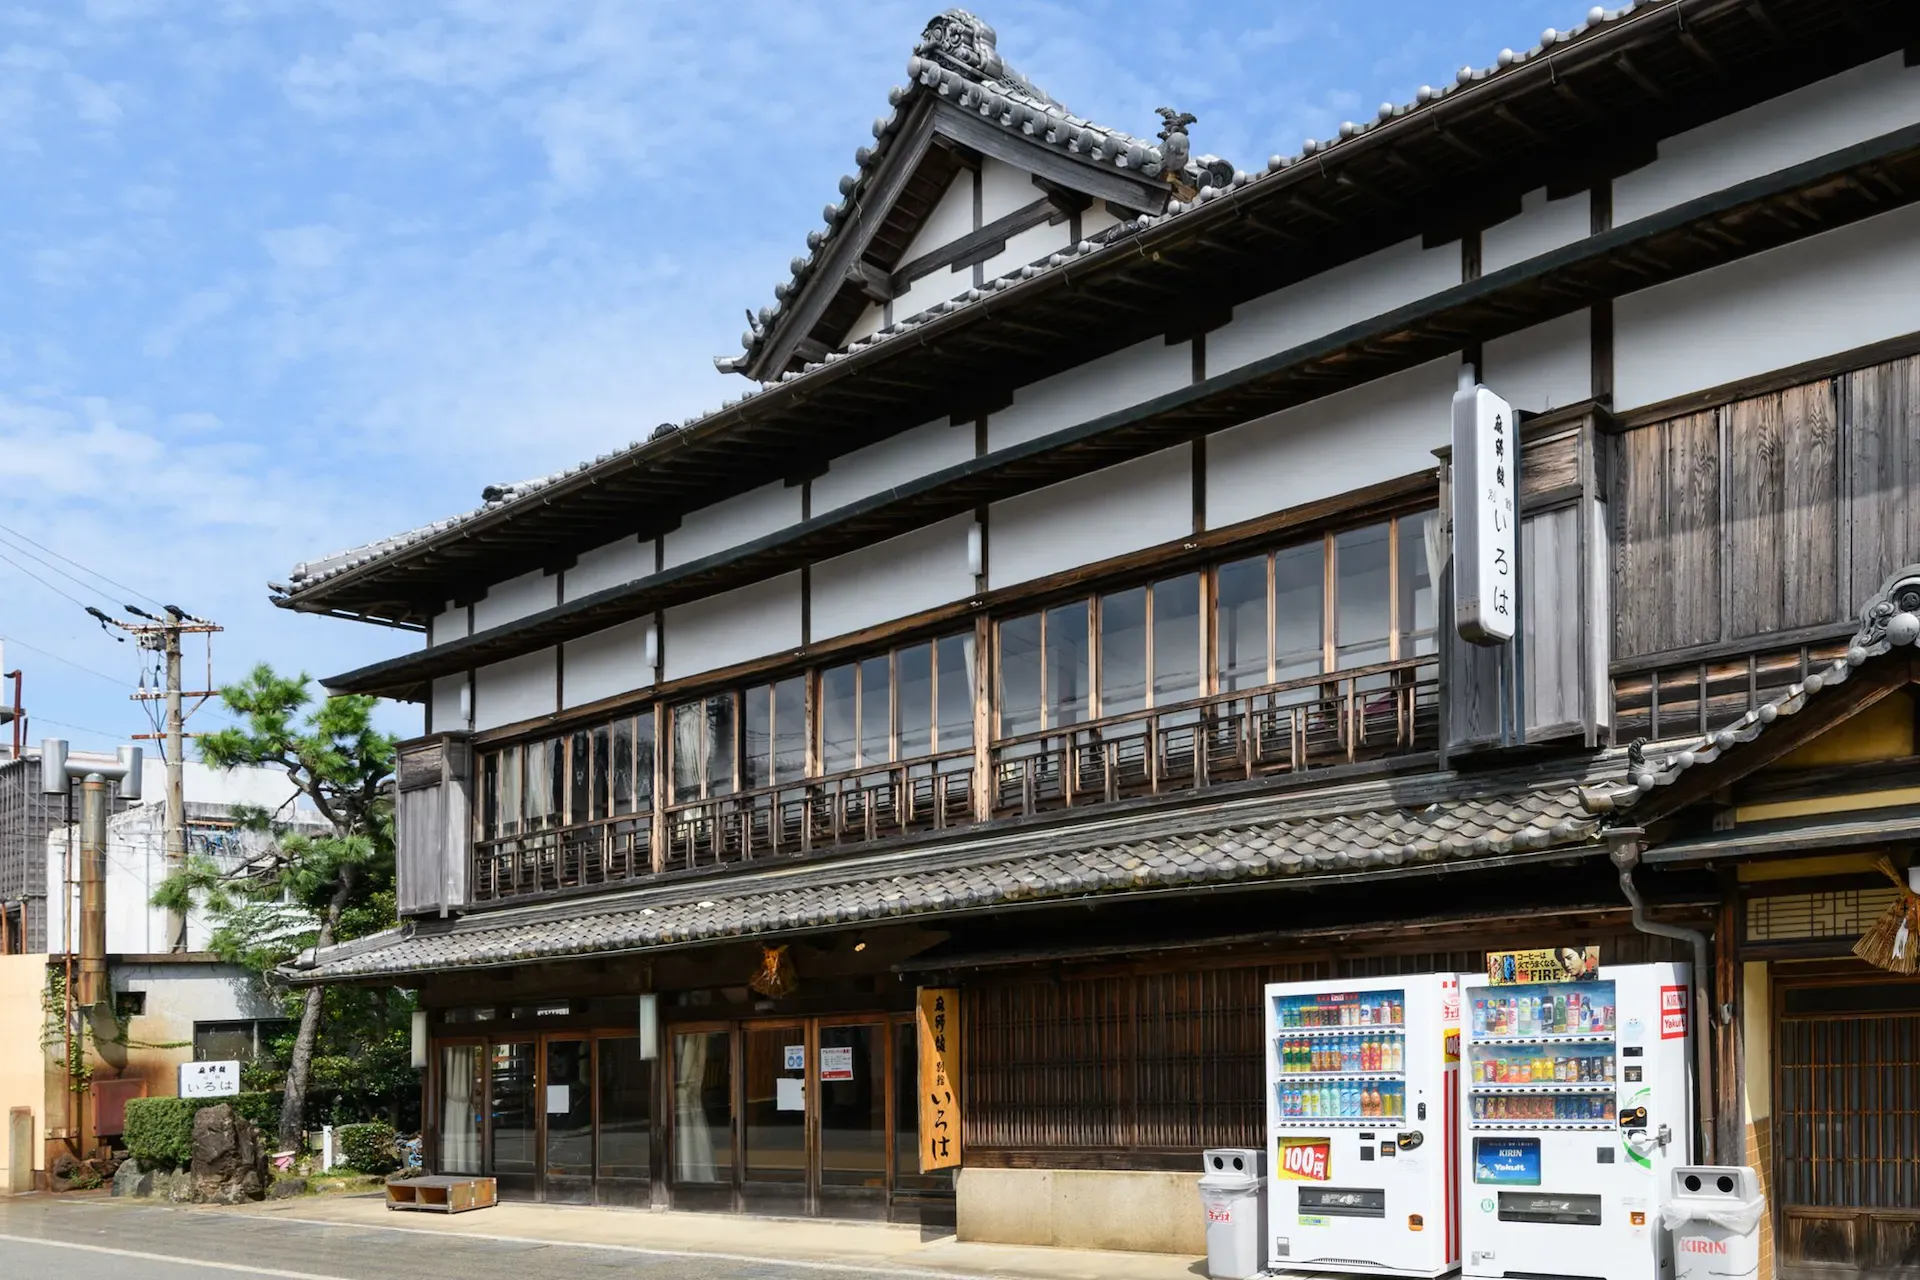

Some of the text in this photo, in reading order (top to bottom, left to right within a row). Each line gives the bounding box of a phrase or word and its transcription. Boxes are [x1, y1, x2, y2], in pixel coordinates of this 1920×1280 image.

[1493, 508, 1509, 616] いろは
[1517, 952, 1547, 961] コーヒーは
[1530, 968, 1561, 982] FIRE
[1665, 993, 1684, 1008] KIRIN
[1664, 1017, 1686, 1029] Yakult
[188, 1081, 233, 1092] いろは
[930, 1091, 951, 1162] いろは
[1499, 1149, 1523, 1158] KIRIN
[1494, 1163, 1527, 1172] Yakult
[1680, 1239, 1728, 1254] KIRIN
